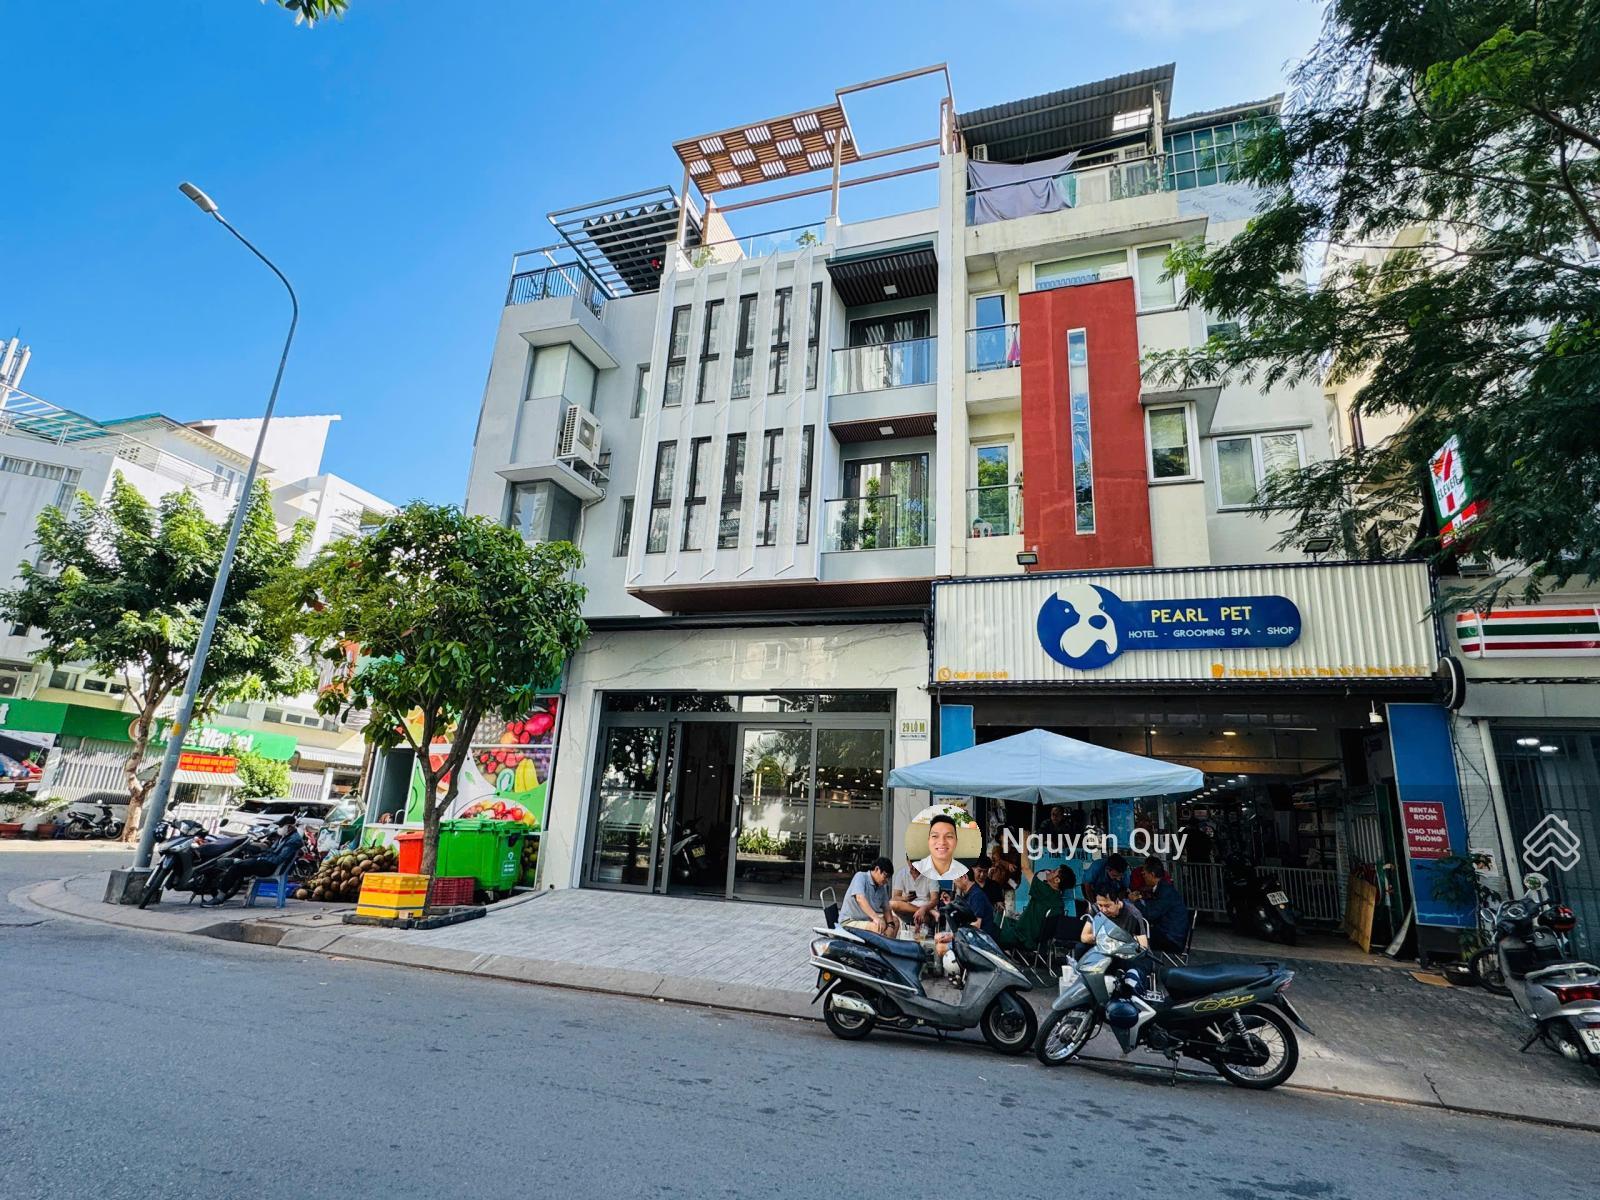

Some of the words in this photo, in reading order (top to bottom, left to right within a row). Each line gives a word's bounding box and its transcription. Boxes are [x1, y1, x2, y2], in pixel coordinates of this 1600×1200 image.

[1151, 608, 1209, 624] PEARL
[1220, 606, 1252, 622] PET
[1128, 630, 1159, 639] HOTEL
[1173, 628, 1225, 638] GROOMING
[1231, 627, 1251, 637] SPA
[1267, 626, 1295, 636] SHOP
[902, 722, 910, 733] 29
[200, 727, 254, 751] Maret
[1426, 827, 1446, 836] THUÊ
[1414, 834, 1443, 842] PHÒNG
